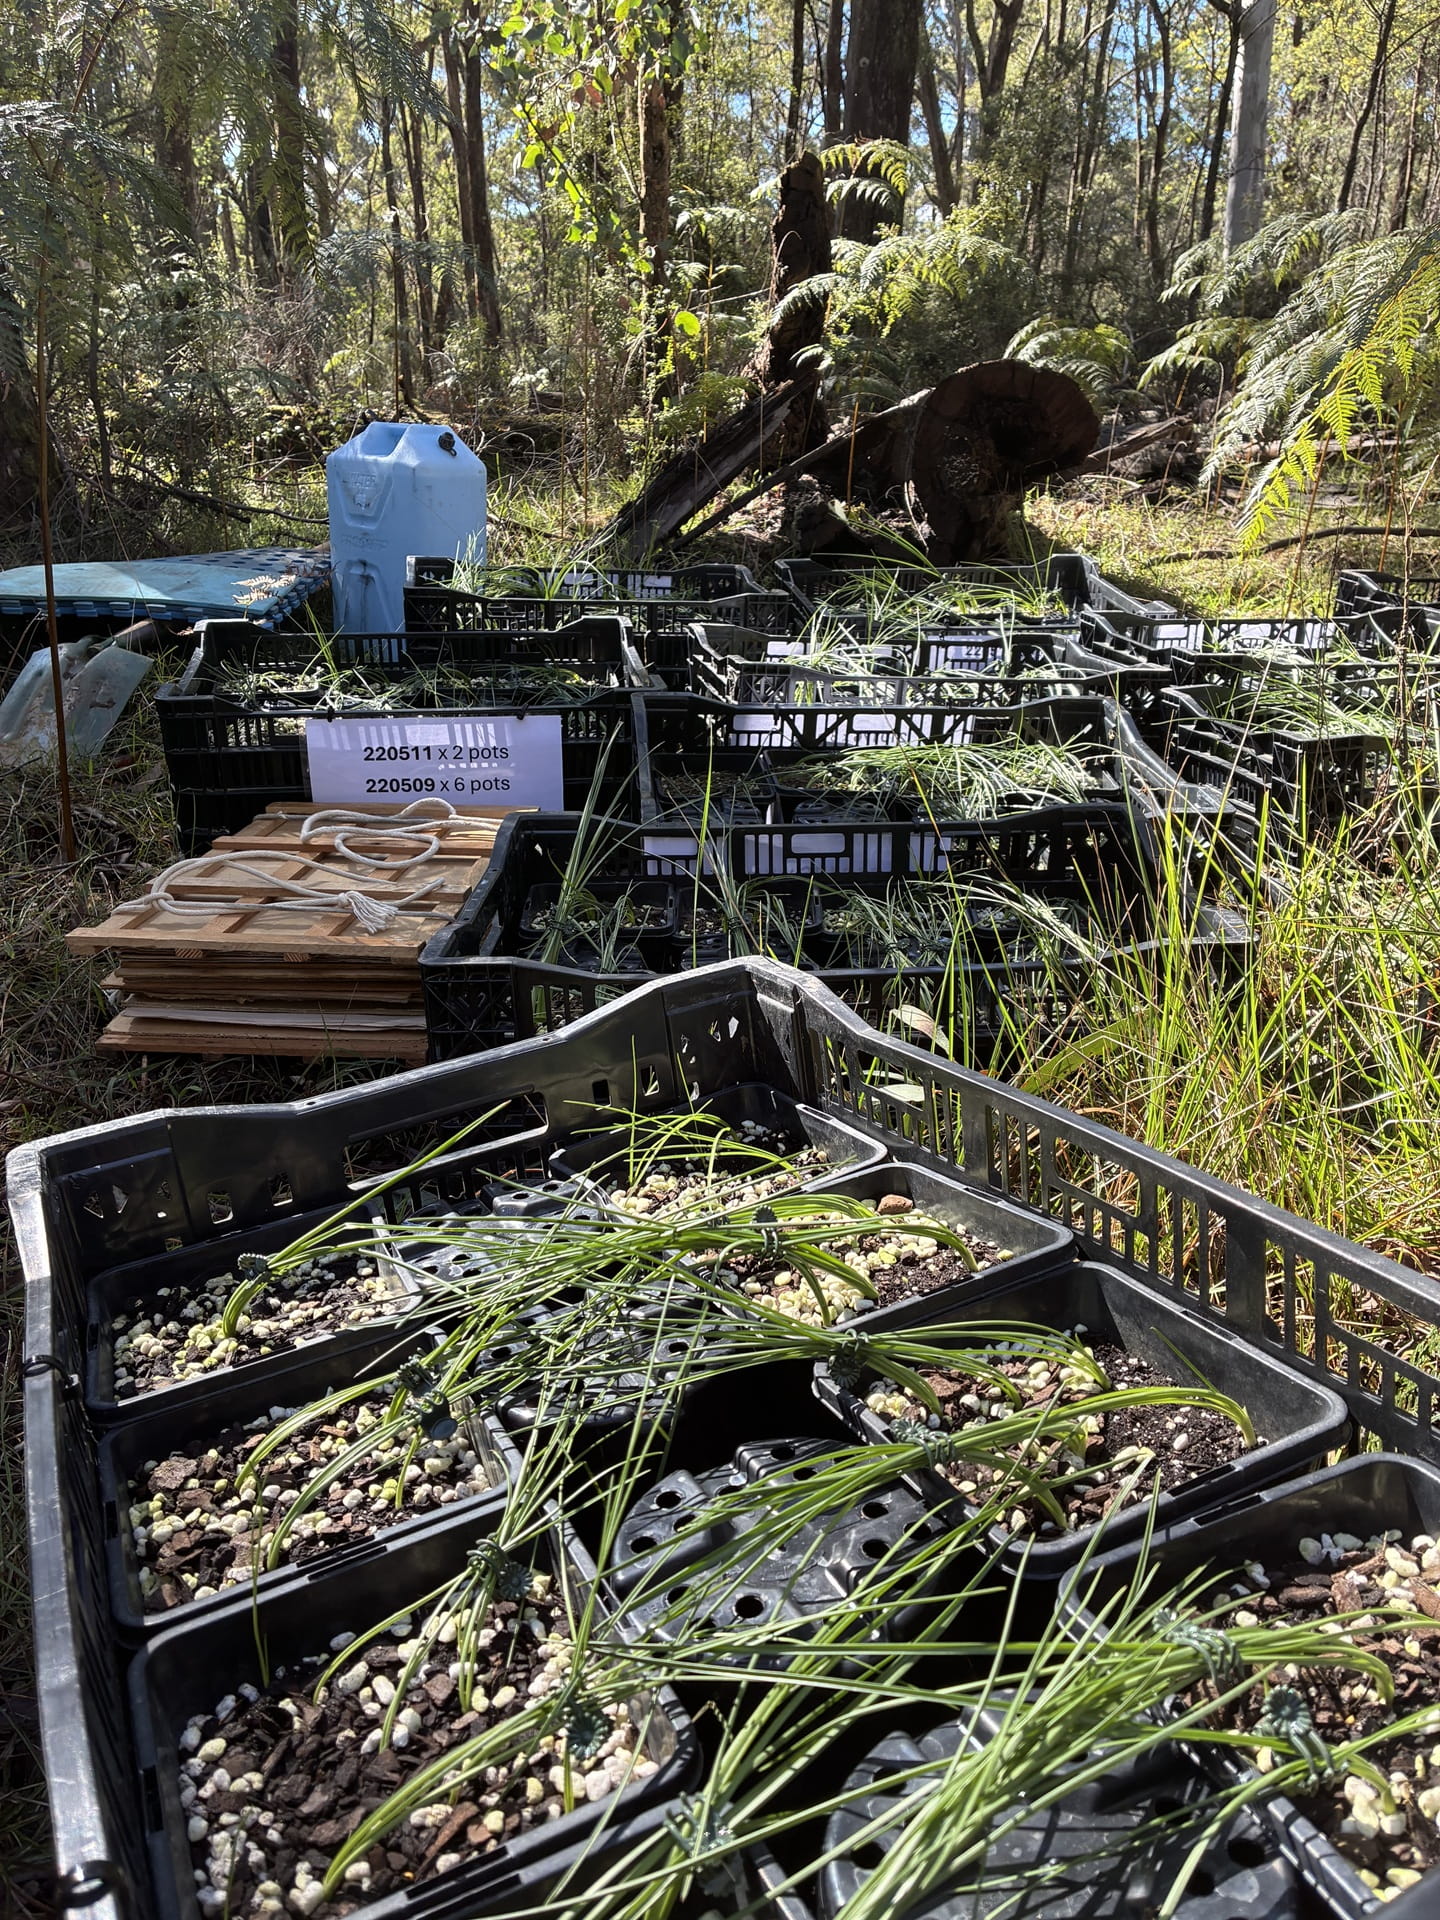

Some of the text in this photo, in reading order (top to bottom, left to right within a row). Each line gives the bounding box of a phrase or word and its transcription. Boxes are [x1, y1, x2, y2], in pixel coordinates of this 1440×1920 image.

[363, 745, 509, 762] 220511 x 2 pots
[366, 777, 510, 794] 220509 x 6 pots
